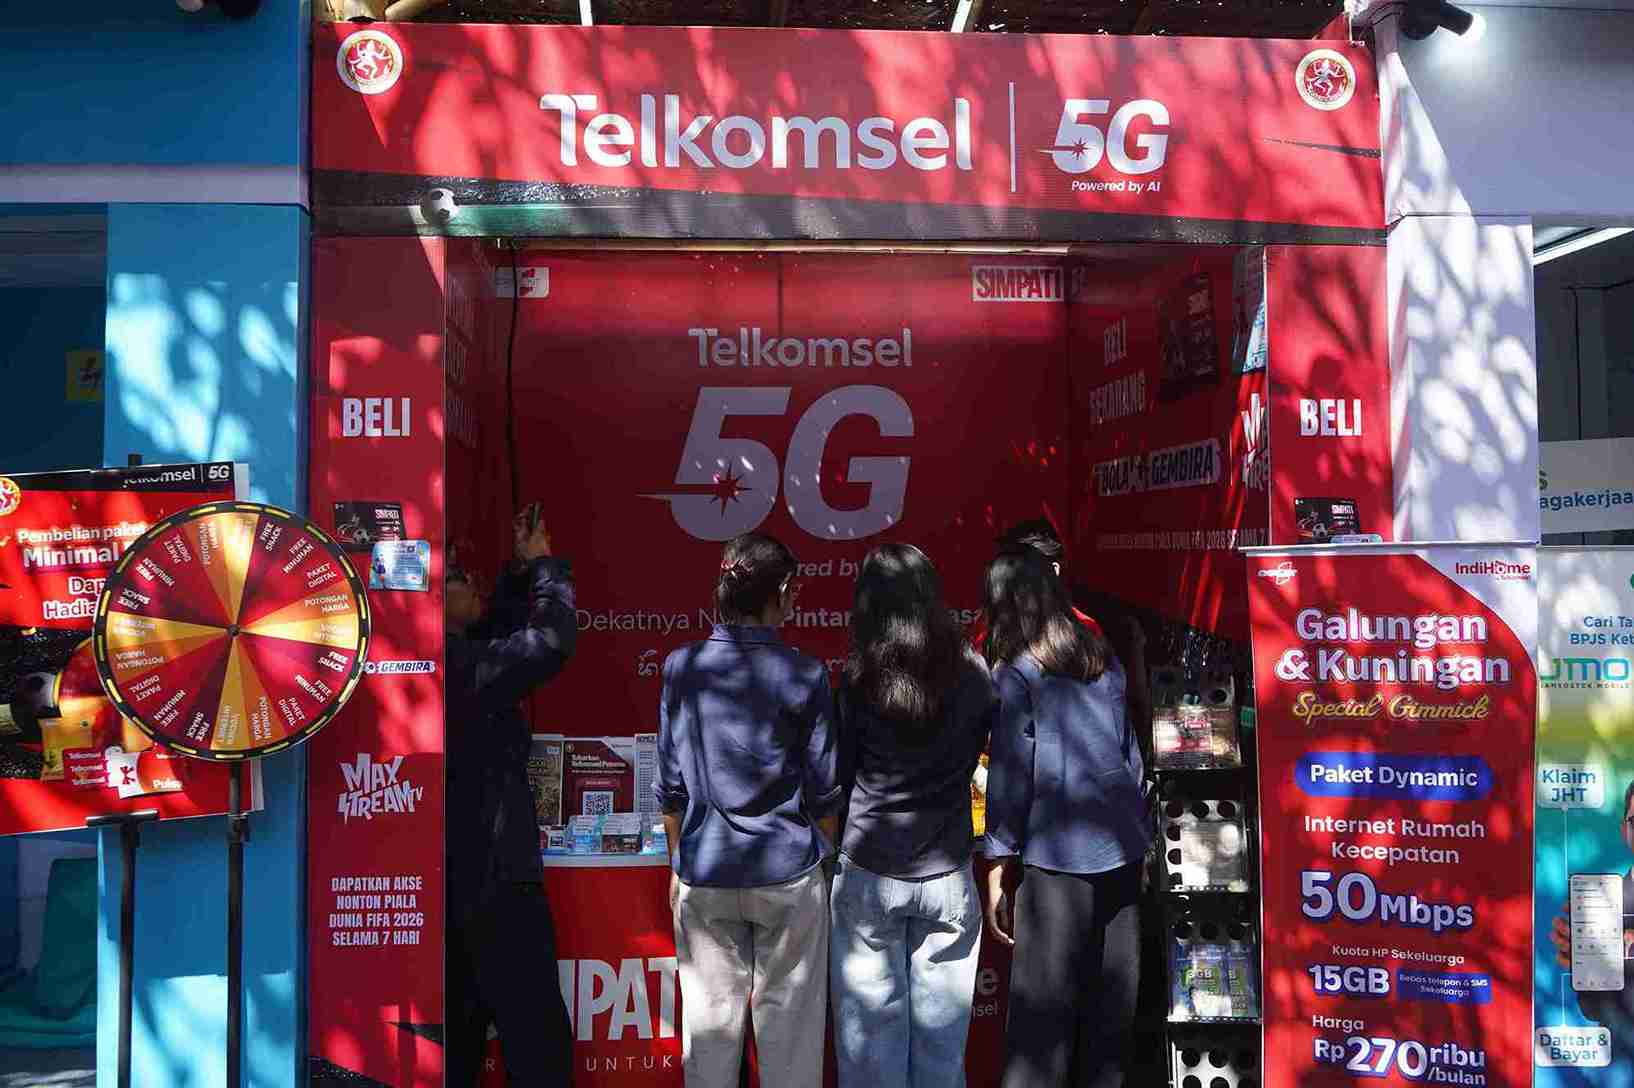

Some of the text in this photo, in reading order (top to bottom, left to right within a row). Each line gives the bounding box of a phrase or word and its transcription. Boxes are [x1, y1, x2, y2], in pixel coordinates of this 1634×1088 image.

[540, 94, 972, 170] Telkomsel
[1051, 99, 1169, 175] 5G
[1071, 180, 1161, 194] Powered by AI
[974, 266, 1062, 300] SIMPATI
[688, 328, 912, 368] Telkomsel
[342, 397, 411, 437] BELI
[1299, 398, 1362, 437] BELI
[208, 465, 230, 479] 5G
[670, 384, 915, 541] 5G
[1539, 489, 1634, 511] agakerjaa
[23, 542, 119, 569] Minimal
[1455, 561, 1530, 574] IndiHome
[43, 598, 98, 619] Hadia
[576, 610, 689, 635] Dekatnya
[1296, 608, 1487, 649] Galungan
[1583, 616, 1613, 628] Cari
[1570, 633, 1607, 645] BPJS
[381, 662, 433, 673] GEMBIRA
[1275, 648, 1512, 690] & Kuningan
[1293, 692, 1489, 726] Special Gimmick
[340, 752, 404, 793] MAX
[1310, 765, 1478, 788] Paket Dynamic
[1543, 768, 1596, 784] Klaim
[1551, 788, 1587, 802] JHT
[1304, 816, 1486, 838] Internet Rumah
[1331, 842, 1460, 866] Kecepatan
[331, 877, 390, 892] DAPATKAN
[336, 894, 417, 910] NONTON PIALA
[1302, 872, 1474, 932] 50 Mbps
[329, 912, 424, 928] DUNIA FIFA 2026
[332, 930, 420, 946] SELAMA 7 HARI
[1332, 946, 1465, 967] Kuota HP Sekeluarga
[1308, 964, 1390, 994] 15GB
[1312, 1014, 1365, 1033] Harga
[1539, 1033, 1608, 1046] Daftar &
[585, 1054, 673, 1072] UNTUK
[1314, 1036, 1486, 1077] Rp 270 ribu
[1551, 1047, 1599, 1062] Bayar
[1428, 1067, 1486, 1085] /bulan
